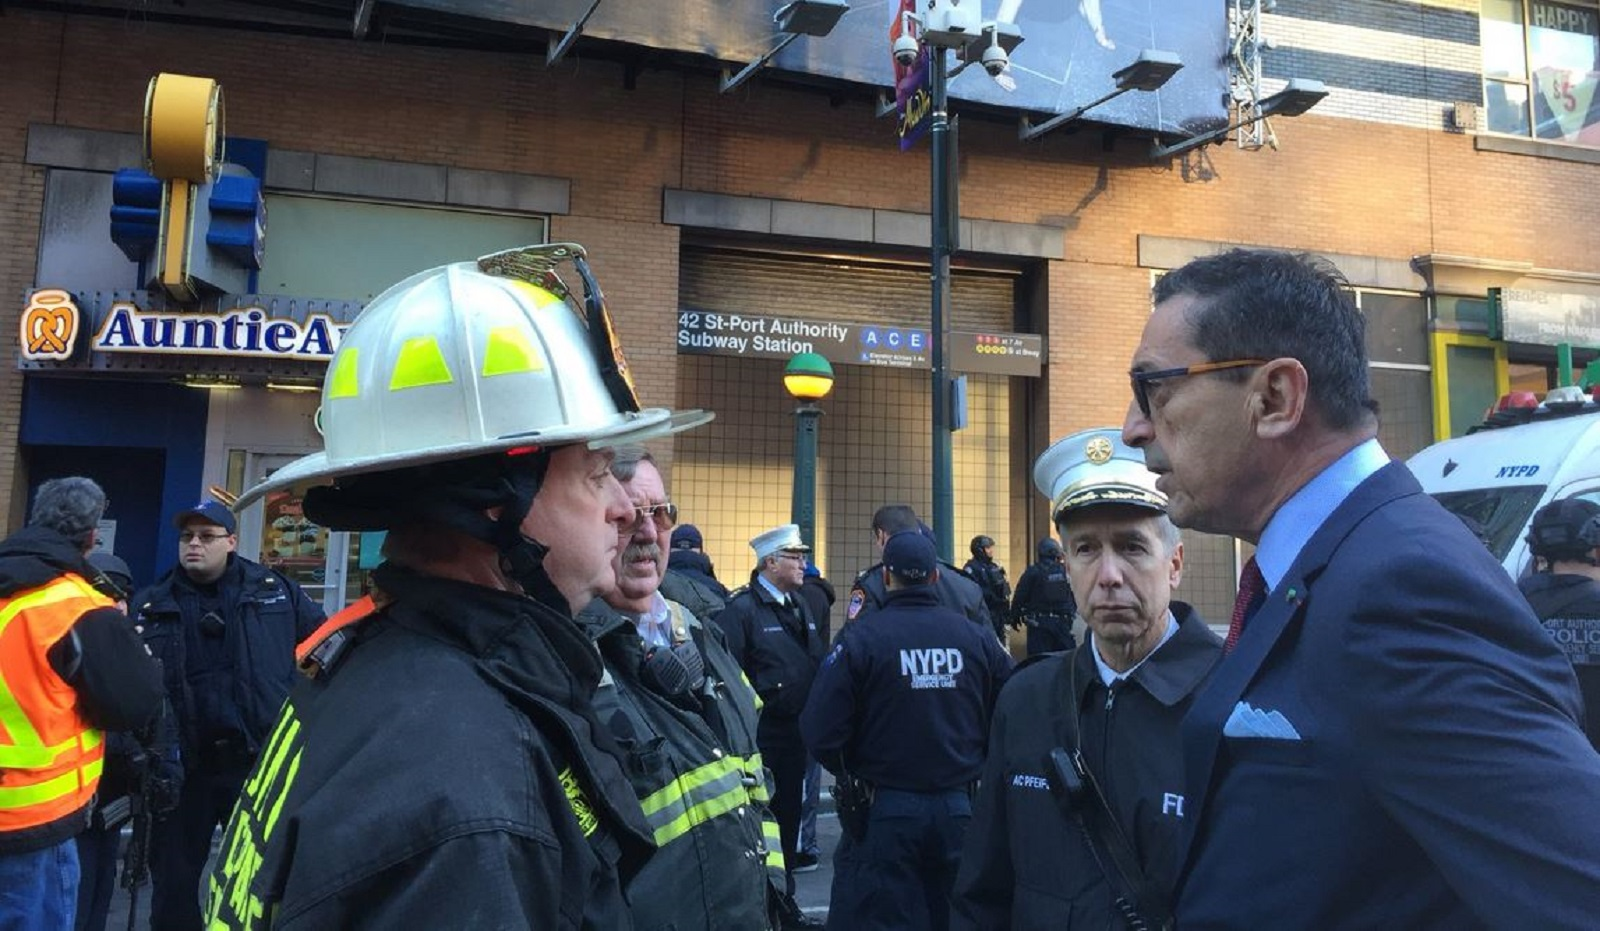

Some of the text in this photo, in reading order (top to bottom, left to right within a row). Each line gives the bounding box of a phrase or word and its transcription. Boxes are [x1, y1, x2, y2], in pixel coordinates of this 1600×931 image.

[1533, 4, 1590, 35] HAPPY
[678, 312, 848, 342] 42 St-Port Authority
[867, 331, 921, 347] A C E
[678, 330, 813, 354] Subway Station
[1495, 465, 1540, 479] NYPD
[900, 648, 964, 676] NYPD
